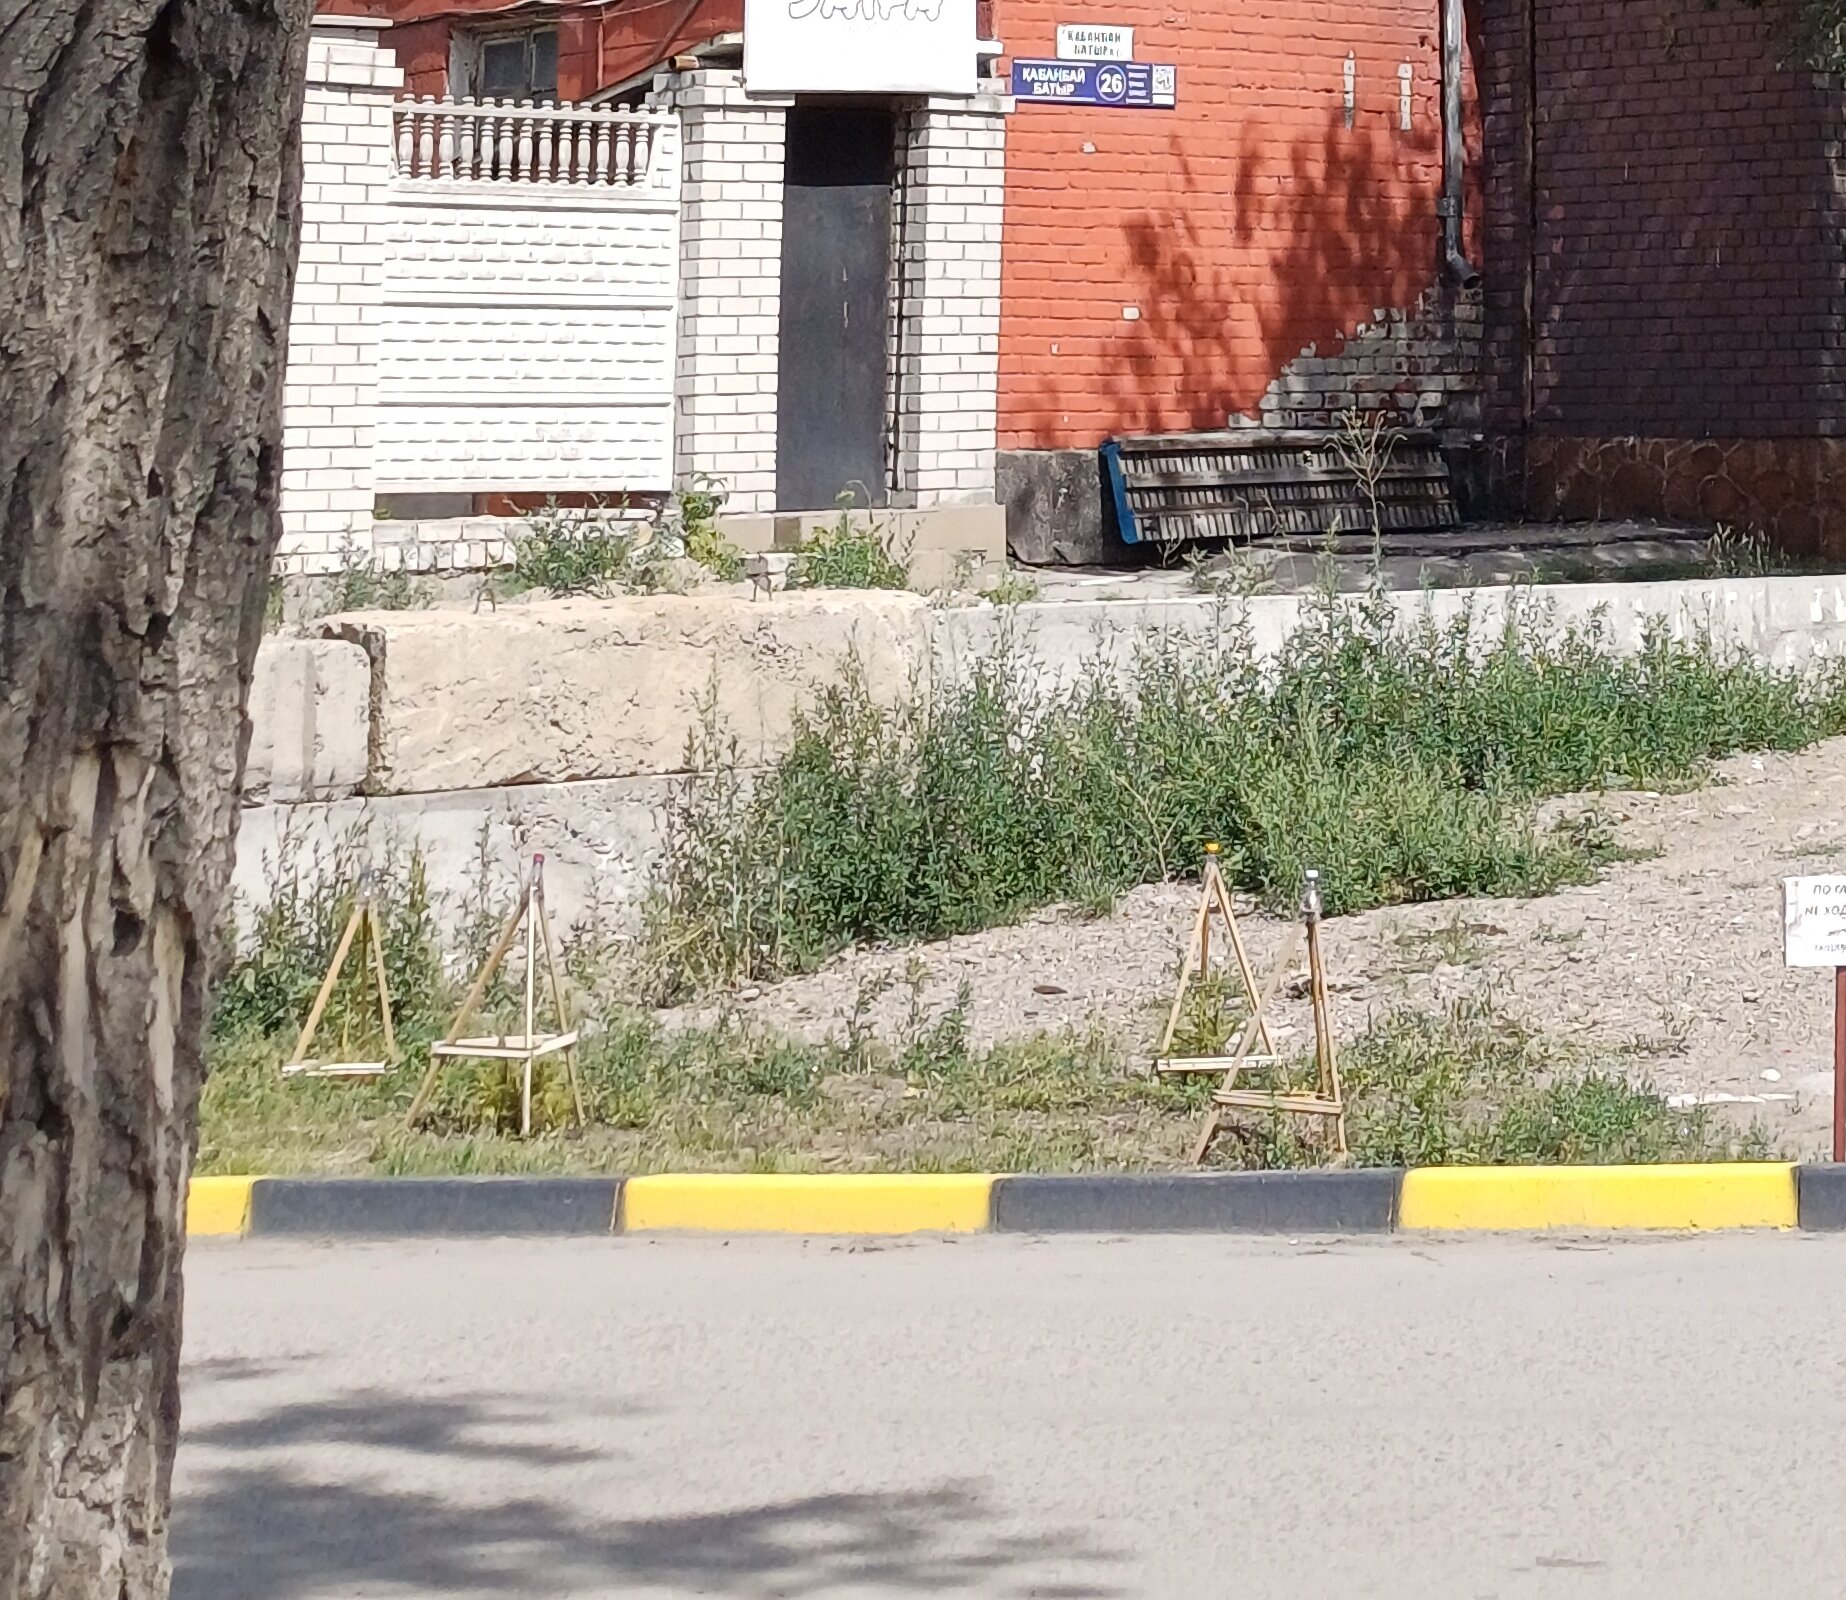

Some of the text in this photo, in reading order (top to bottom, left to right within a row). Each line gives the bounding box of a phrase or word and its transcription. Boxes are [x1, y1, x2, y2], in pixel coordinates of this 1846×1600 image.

[1032, 81, 1075, 96] БАТЫР
[1101, 73, 1123, 94] 26
[1813, 884, 1831, 895] ПО
